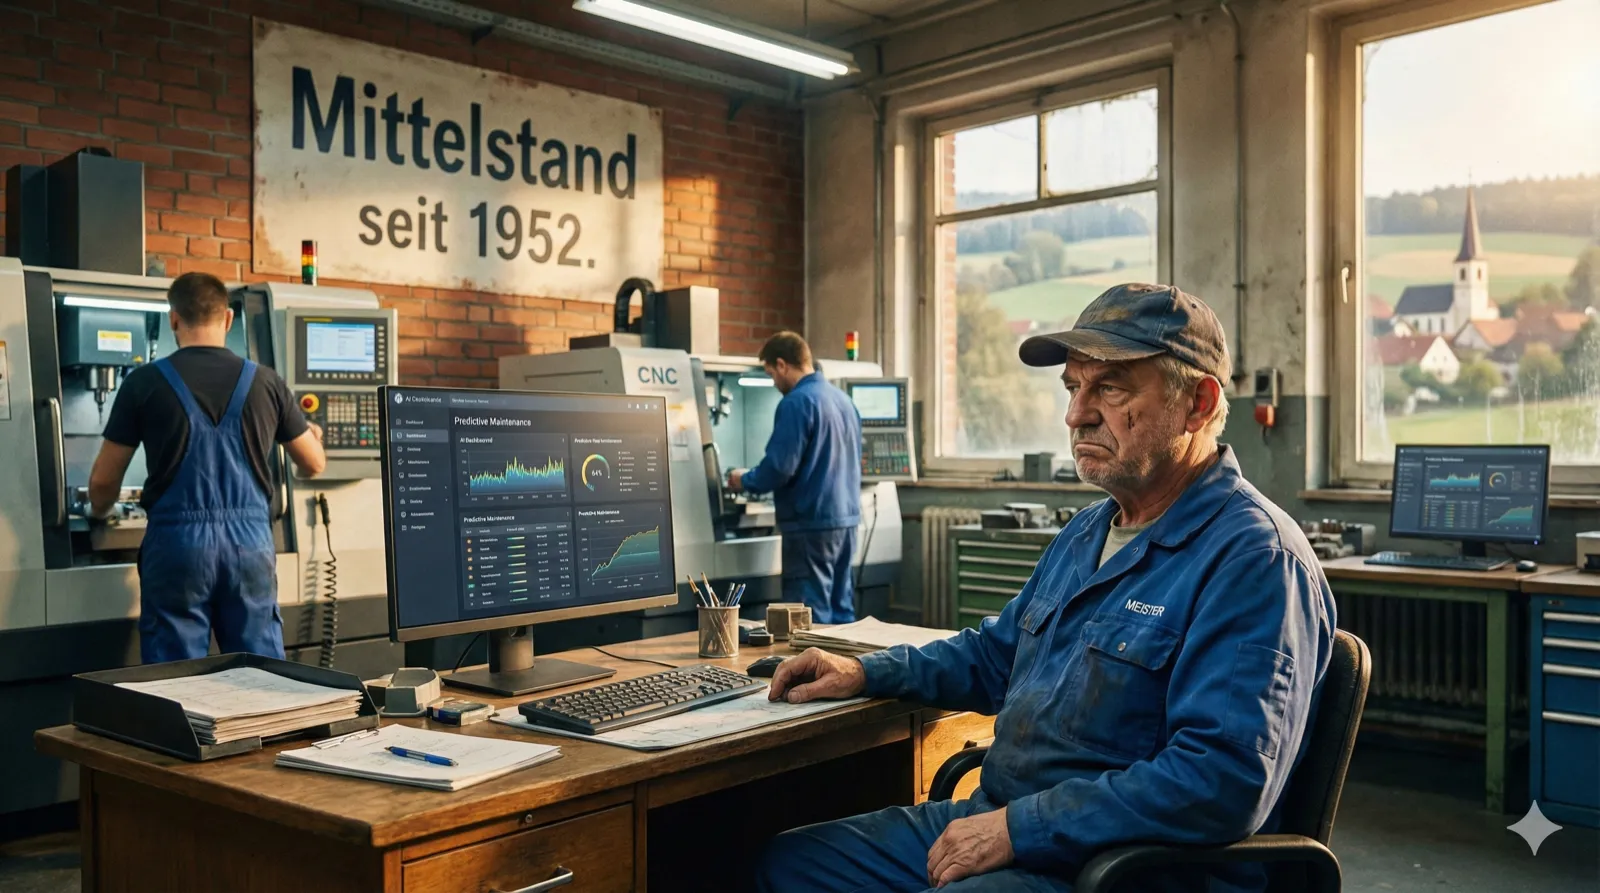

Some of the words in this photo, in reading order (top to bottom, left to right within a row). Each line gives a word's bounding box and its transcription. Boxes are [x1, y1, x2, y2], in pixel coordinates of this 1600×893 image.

[291, 66, 637, 200] Mittelstand
[358, 196, 448, 254] seit
[469, 202, 596, 269] 1952.
[637, 366, 678, 385] CNC
[454, 416, 488, 426] Predictive
[489, 417, 531, 426] Maintenance
[1125, 599, 1165, 616] MEISTER
